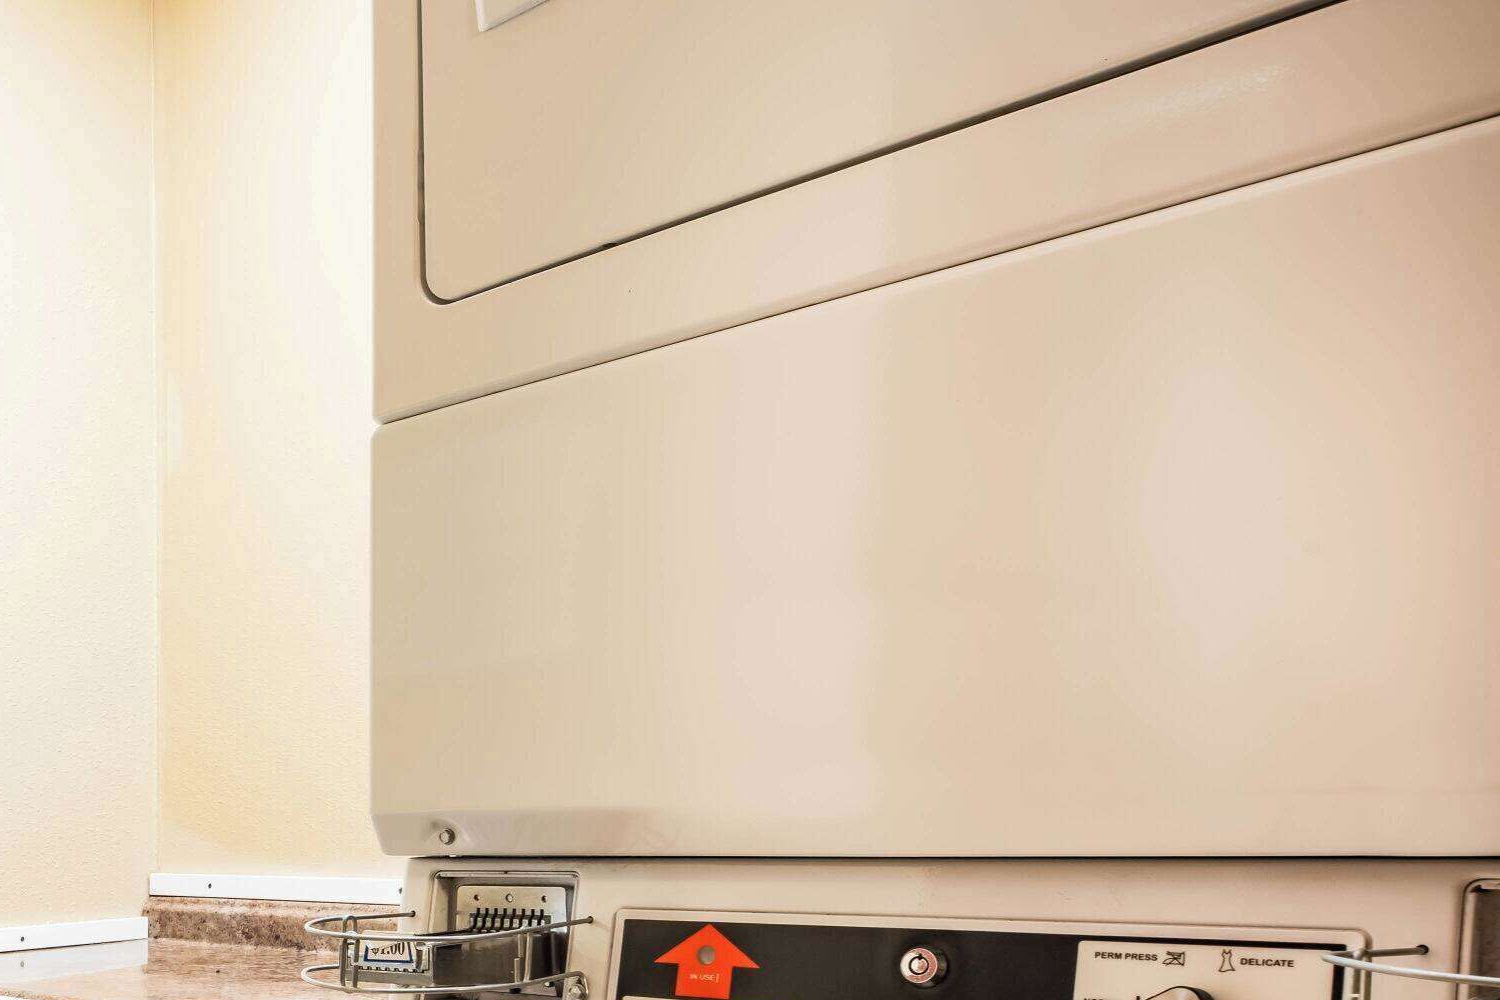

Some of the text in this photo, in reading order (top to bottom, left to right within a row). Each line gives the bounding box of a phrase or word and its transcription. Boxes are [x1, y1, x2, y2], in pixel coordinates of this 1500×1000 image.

[1094, 951, 1158, 962] PERM PRESS
[1240, 958, 1295, 968] DELICATE
